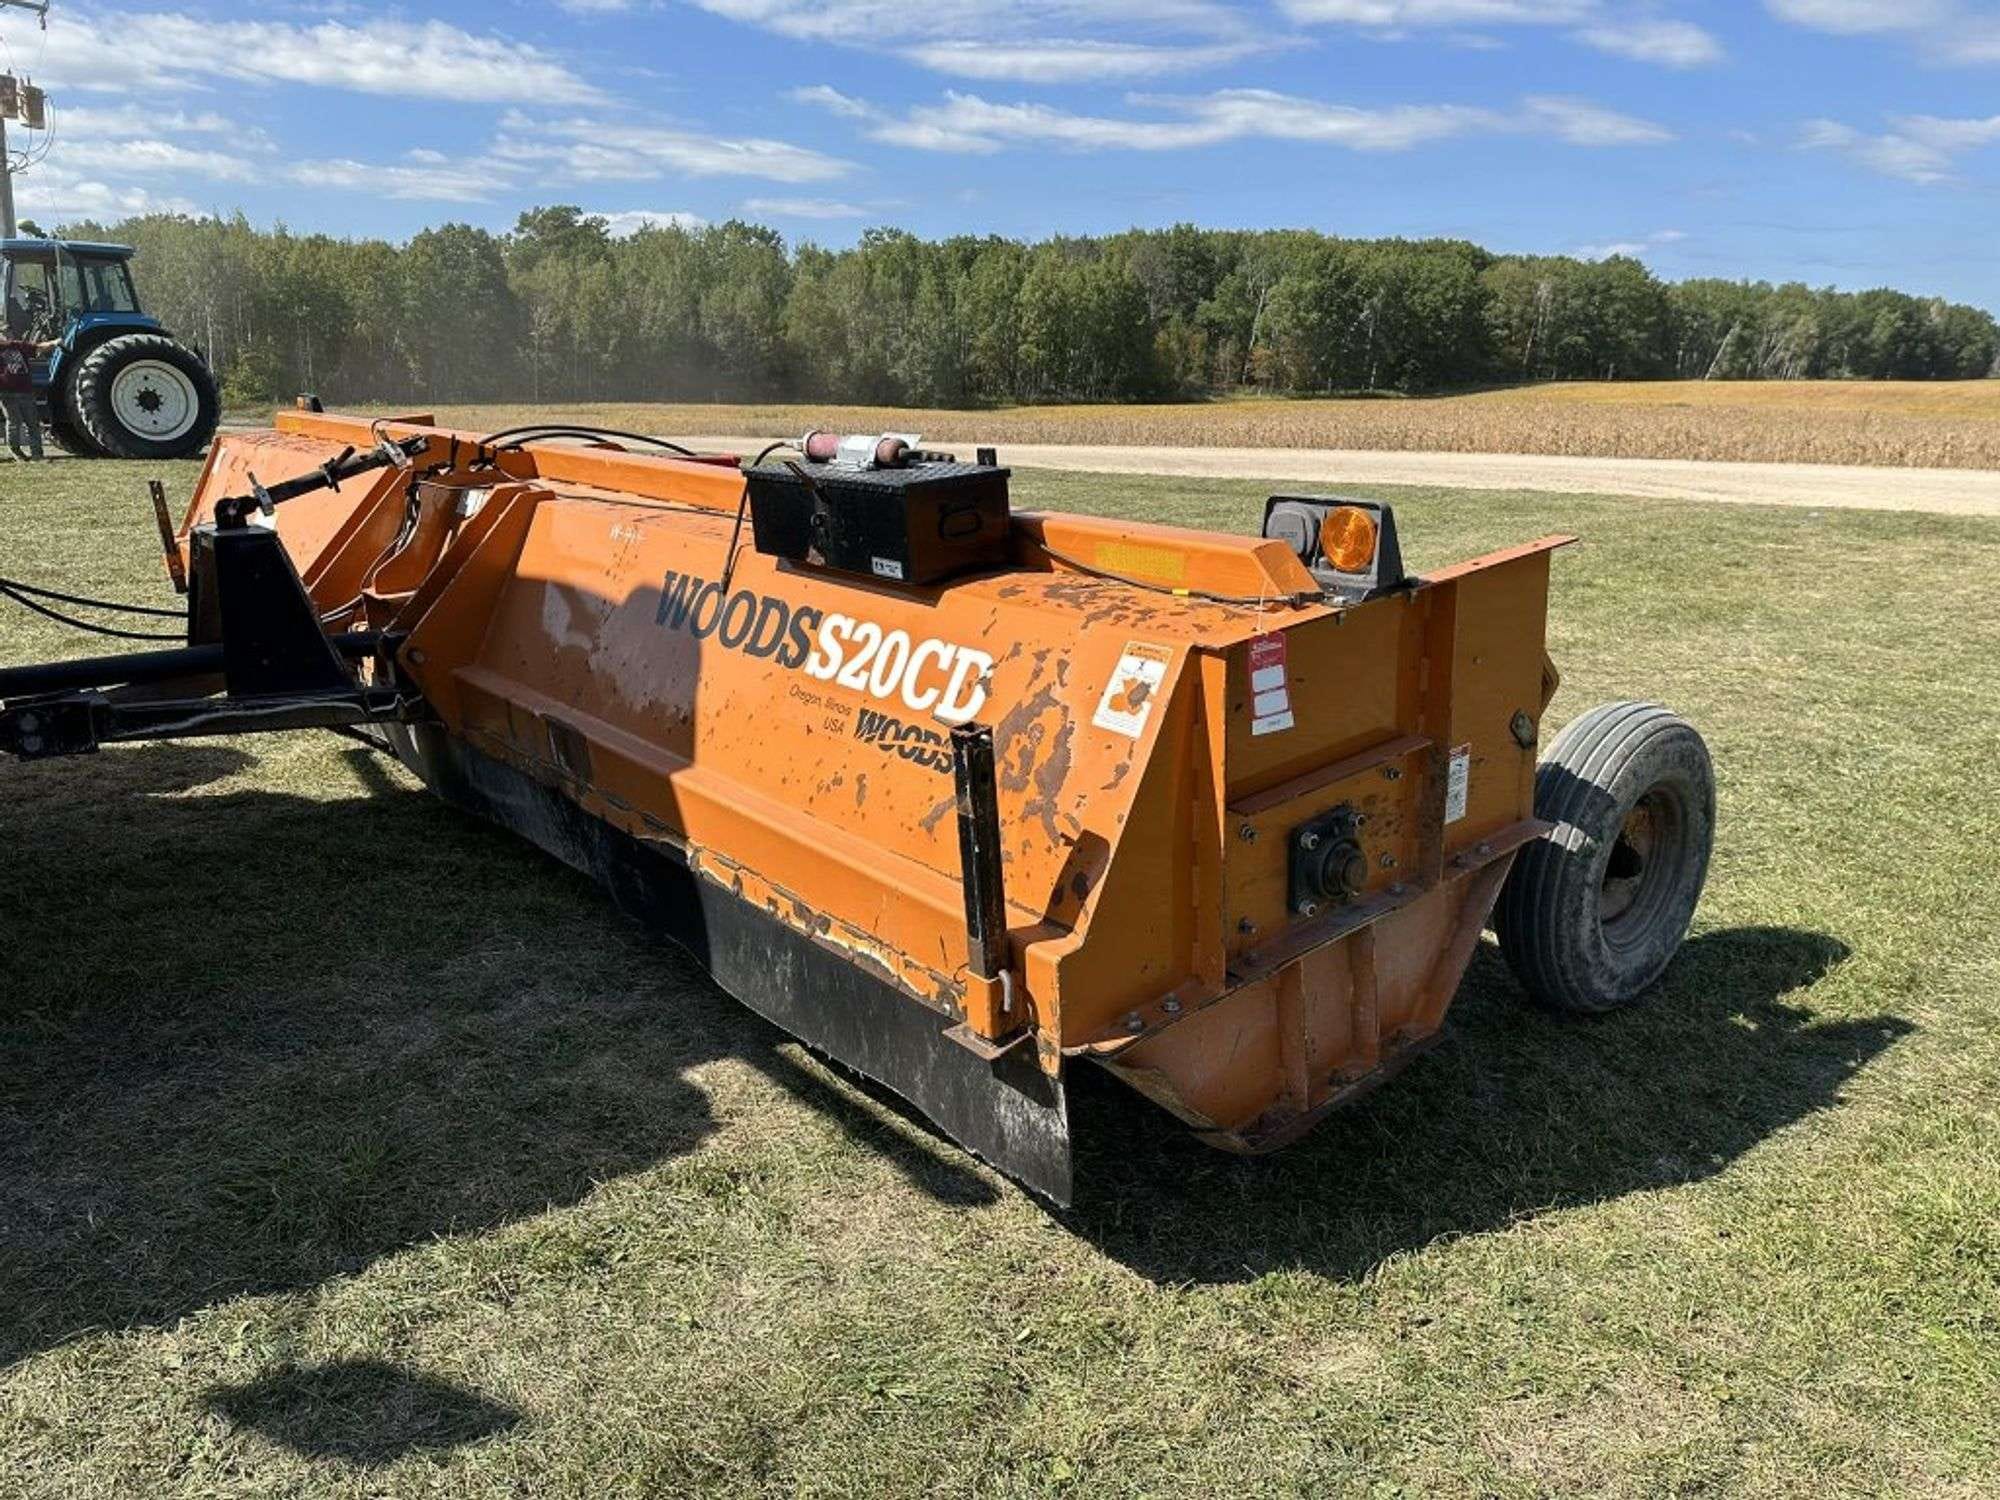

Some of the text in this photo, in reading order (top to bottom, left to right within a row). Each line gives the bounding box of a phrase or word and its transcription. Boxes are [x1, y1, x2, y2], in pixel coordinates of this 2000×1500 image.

[654, 570, 995, 724] WOODS S20CD
[823, 716, 846, 736] USA
[853, 706, 953, 775] WOODS
